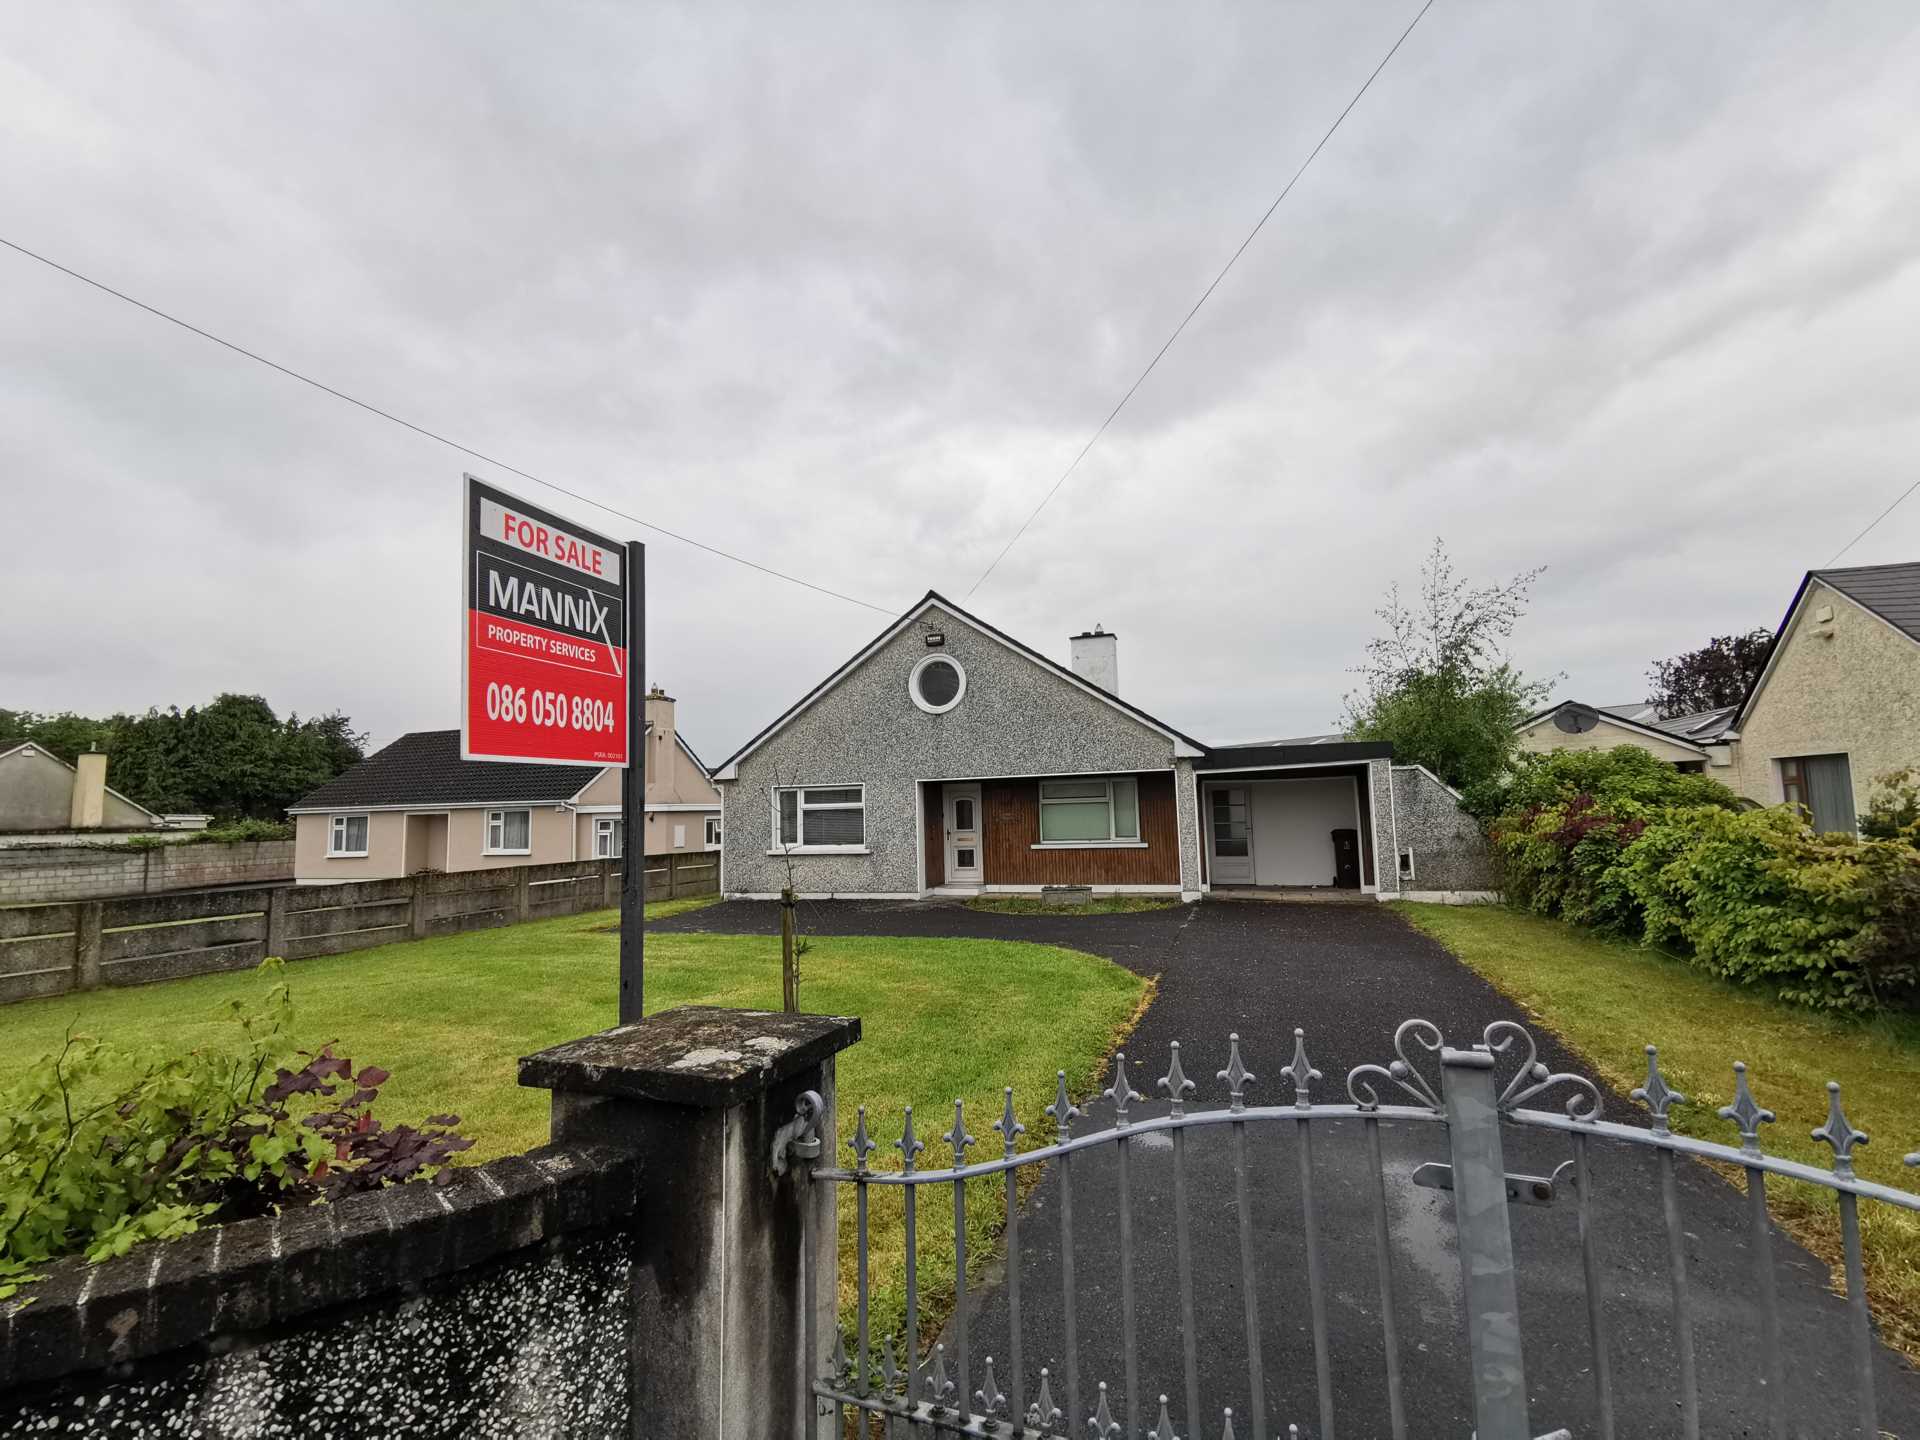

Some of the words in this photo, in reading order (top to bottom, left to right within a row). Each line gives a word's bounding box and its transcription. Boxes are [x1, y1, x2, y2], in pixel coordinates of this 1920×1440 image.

[504, 513, 548, 555] FOR
[554, 535, 602, 575] SALE
[489, 570, 610, 638] MANNIX
[488, 624, 547, 651] PROPERTY
[550, 640, 596, 662] SERVICES
[486, 682, 527, 724] 086
[531, 689, 568, 728] 050
[571, 696, 615, 733] 8804
